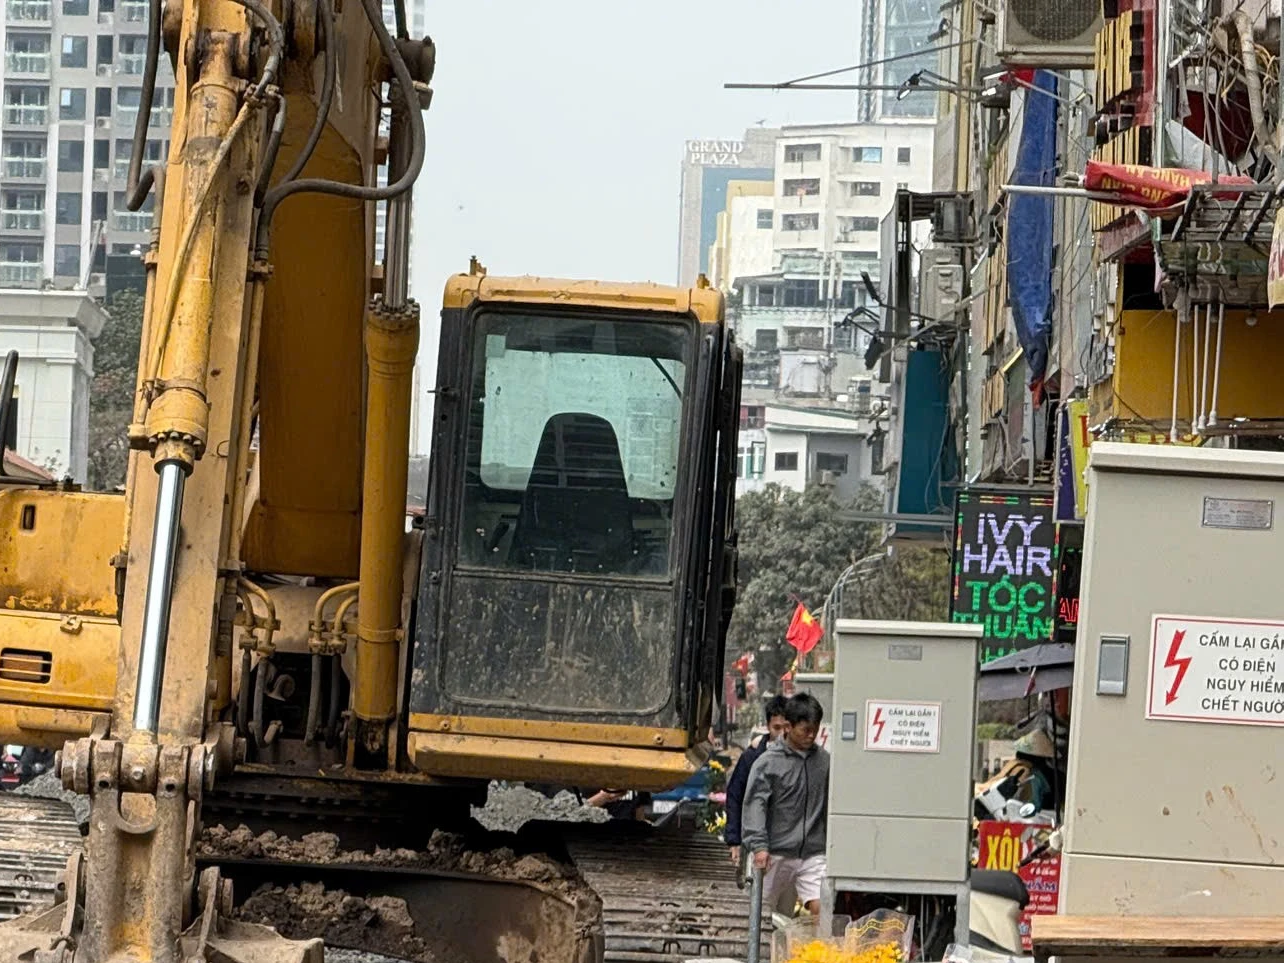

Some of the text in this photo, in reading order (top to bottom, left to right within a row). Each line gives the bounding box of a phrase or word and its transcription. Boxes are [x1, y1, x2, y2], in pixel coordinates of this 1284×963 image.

[688, 141, 744, 153] GRAND
[691, 152, 740, 165] PLAZA
[977, 513, 1044, 545] IVY
[963, 544, 1052, 576] HAIR
[1199, 630, 1230, 647] CẤM
[1234, 636, 1256, 651] LẠI
[1218, 656, 1276, 674] CÓ ĐIỆN
[1206, 678, 1246, 691] NGUY
[1201, 695, 1239, 711] CHẾT
